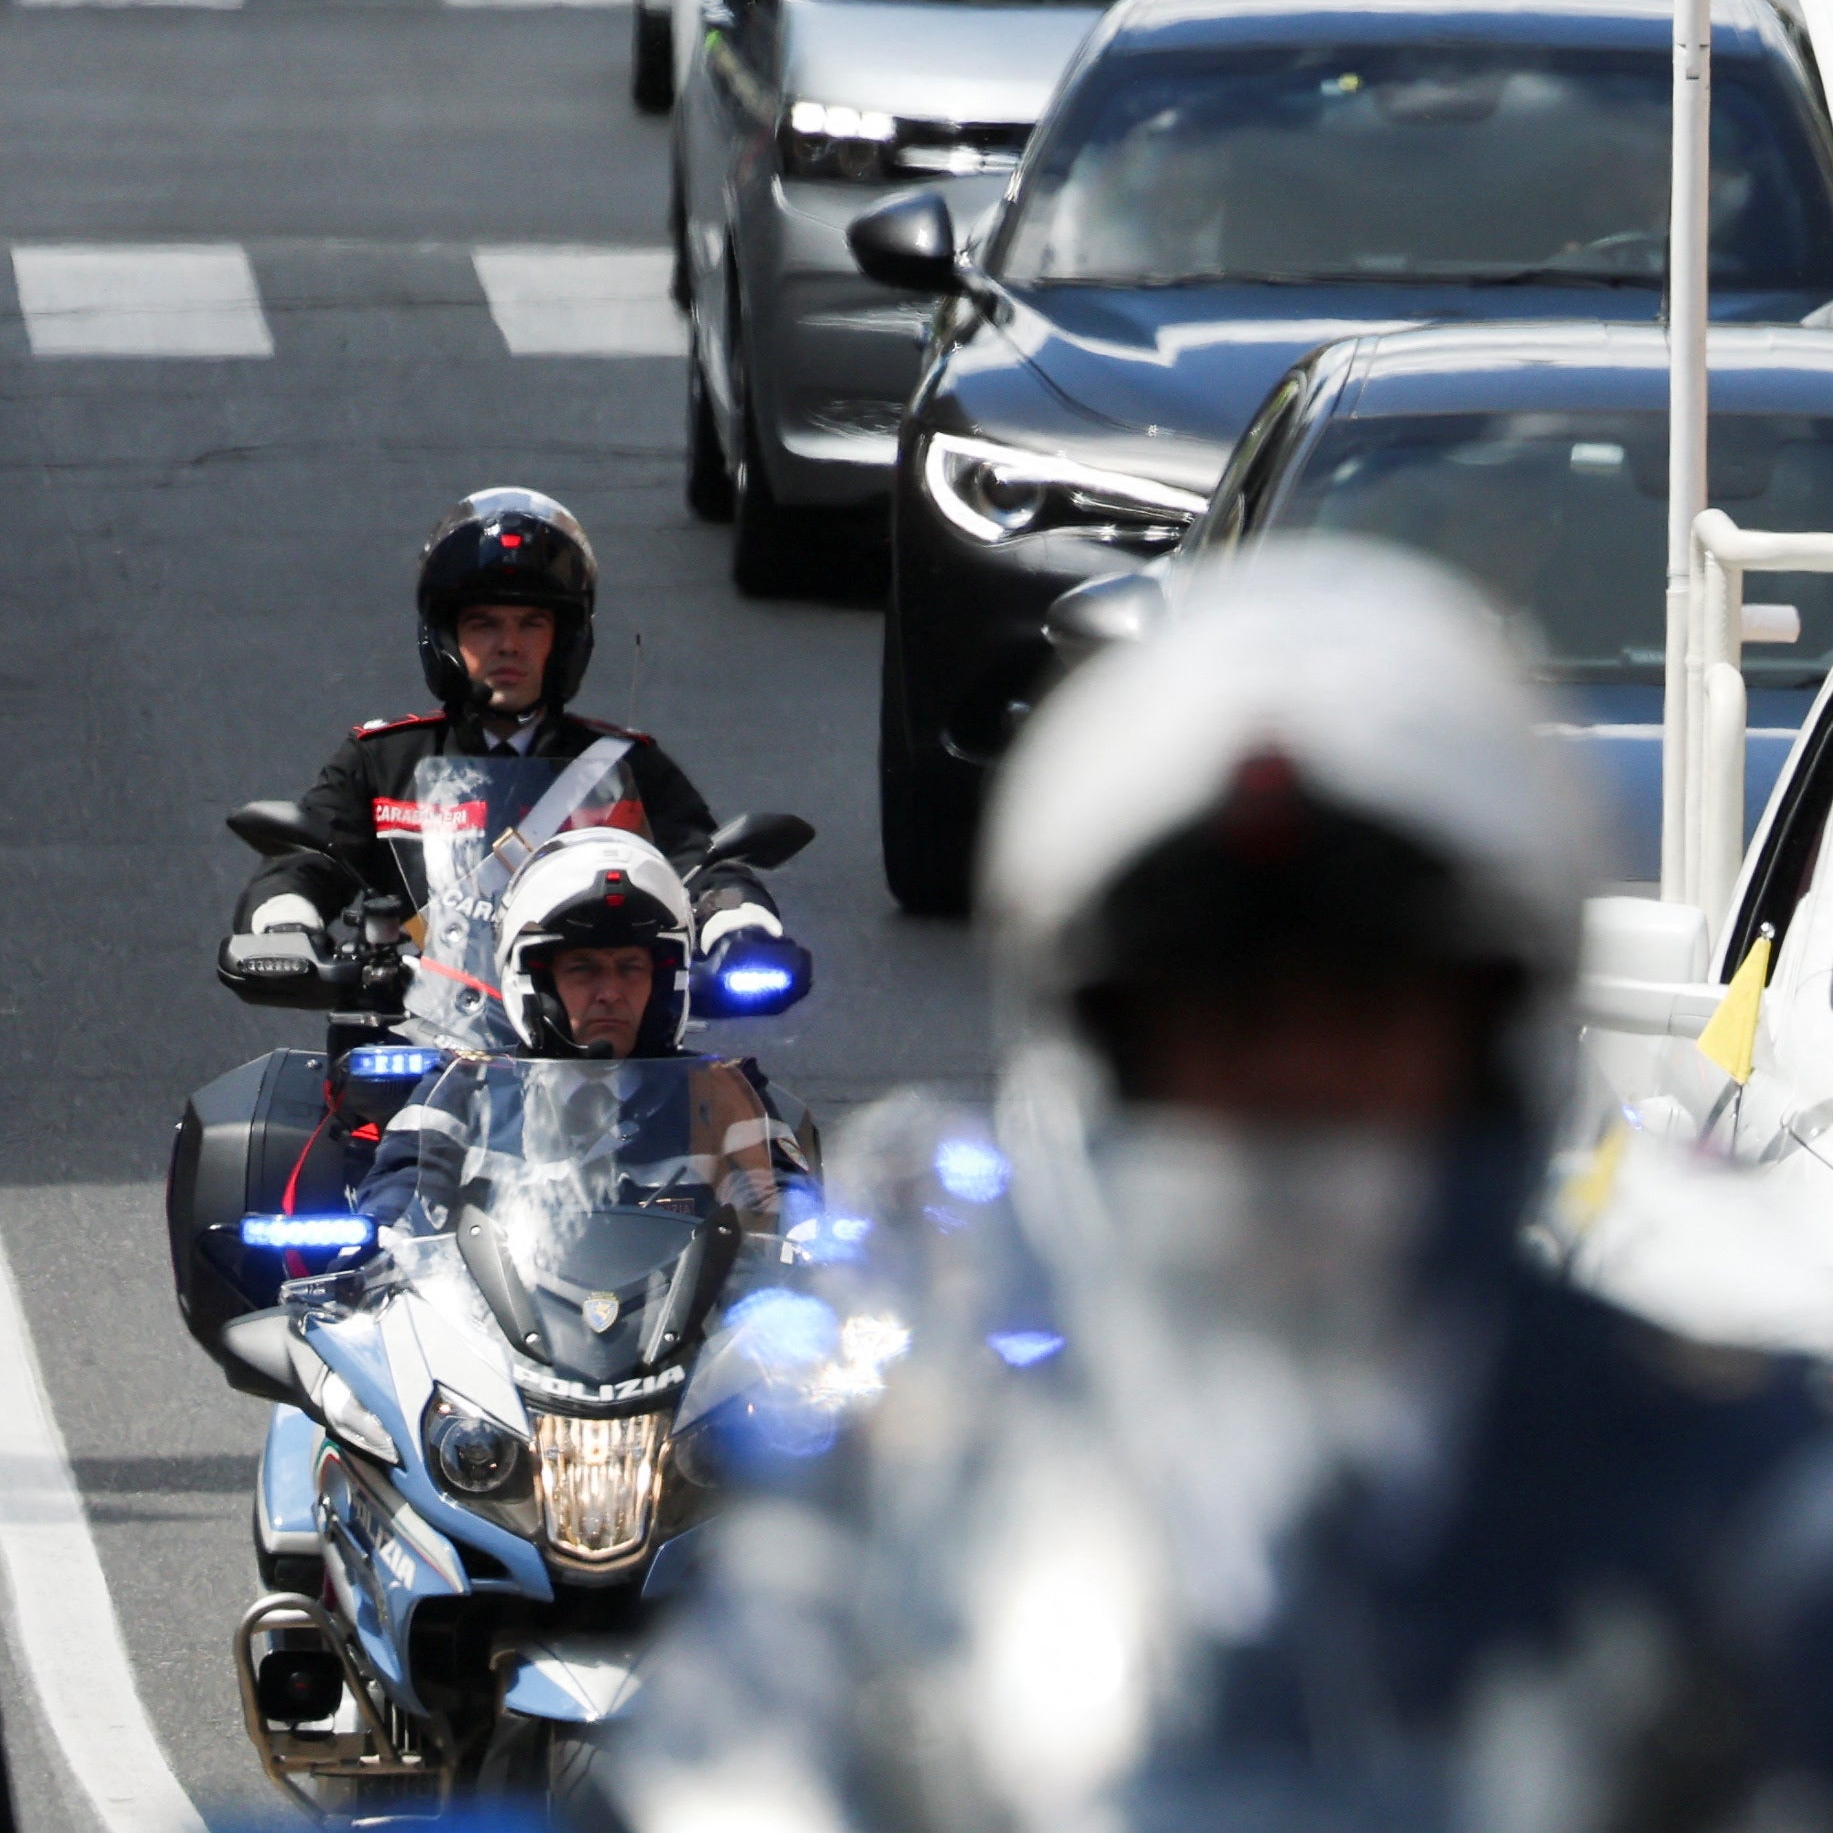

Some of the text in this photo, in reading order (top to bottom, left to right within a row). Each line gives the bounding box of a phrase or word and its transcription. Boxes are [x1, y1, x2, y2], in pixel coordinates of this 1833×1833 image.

[375, 804, 468, 825] CARABIERI
[441, 888, 497, 923] CAR
[511, 1364, 687, 1403] POLIZIA
